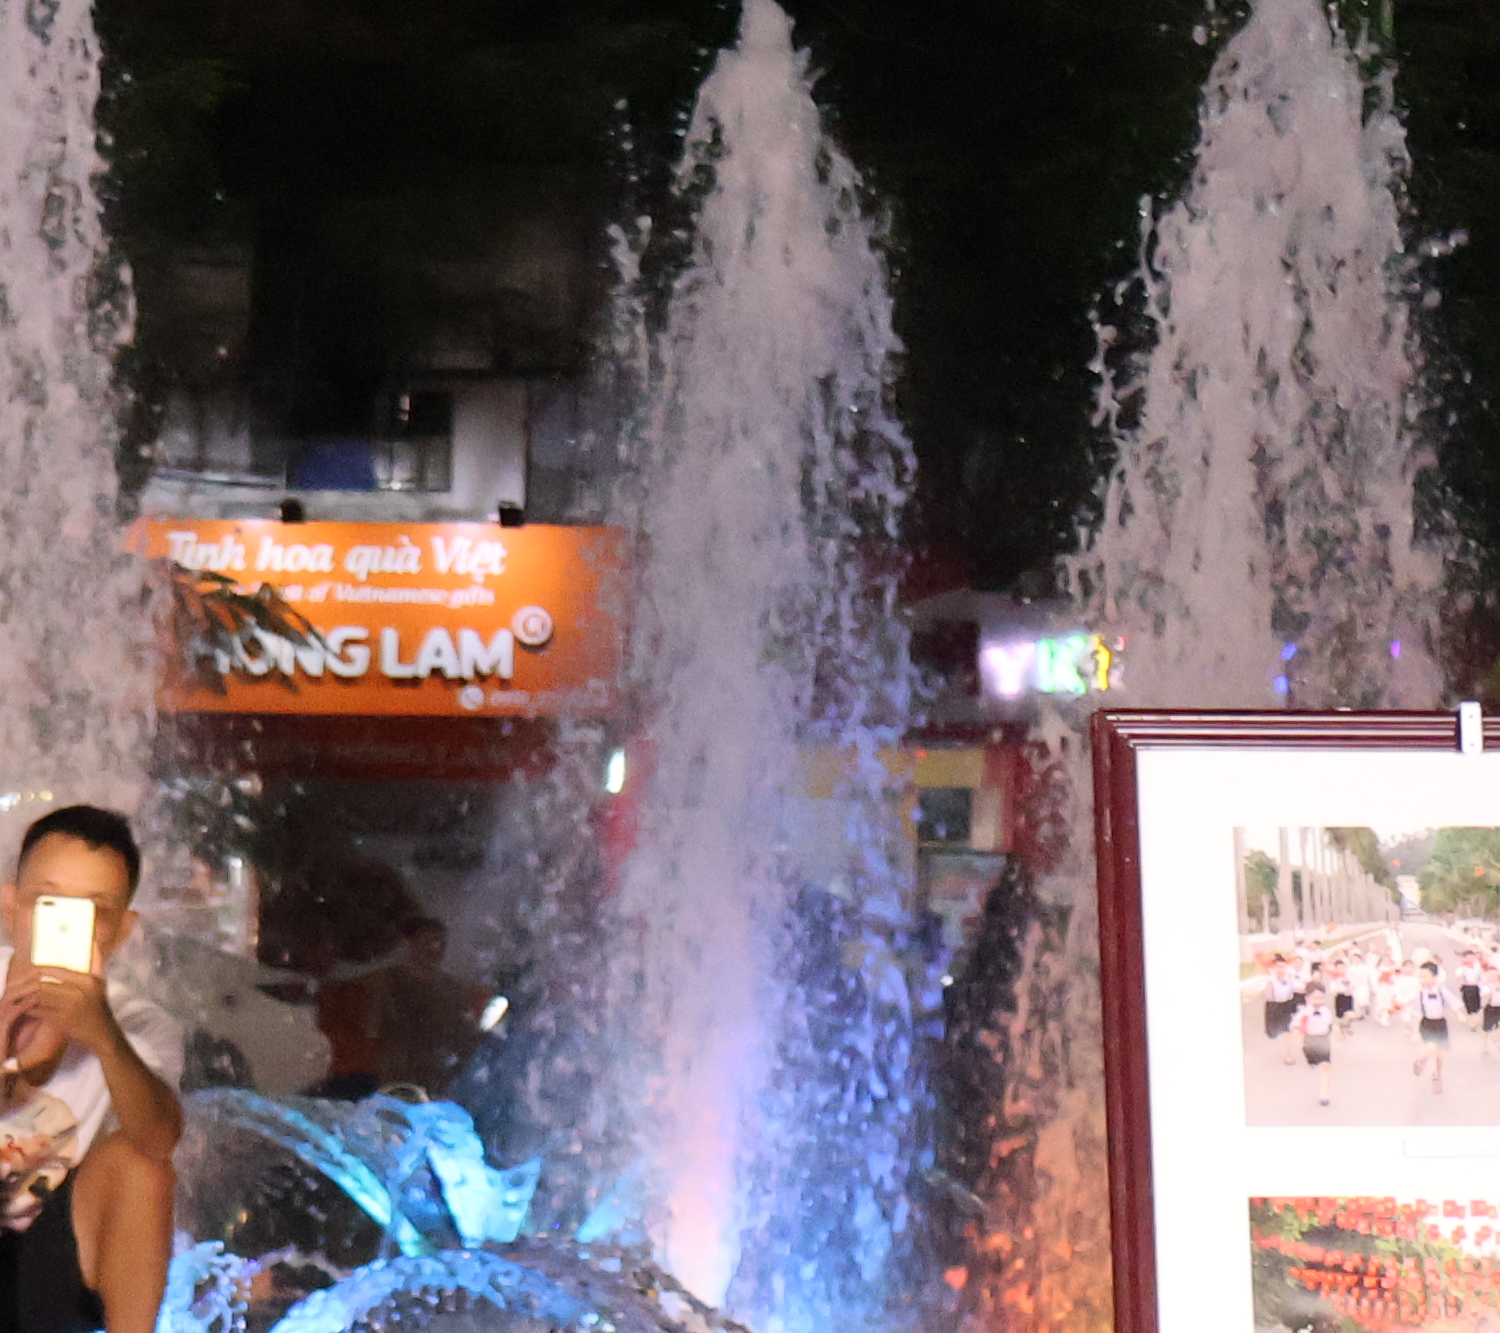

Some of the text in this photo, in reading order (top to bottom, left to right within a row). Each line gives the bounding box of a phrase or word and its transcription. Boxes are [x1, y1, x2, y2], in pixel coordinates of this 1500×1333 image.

[257, 536, 334, 572] hoa
[345, 533, 422, 581] quà
[431, 535, 506, 582] Việt
[381, 626, 514, 679] LAM
